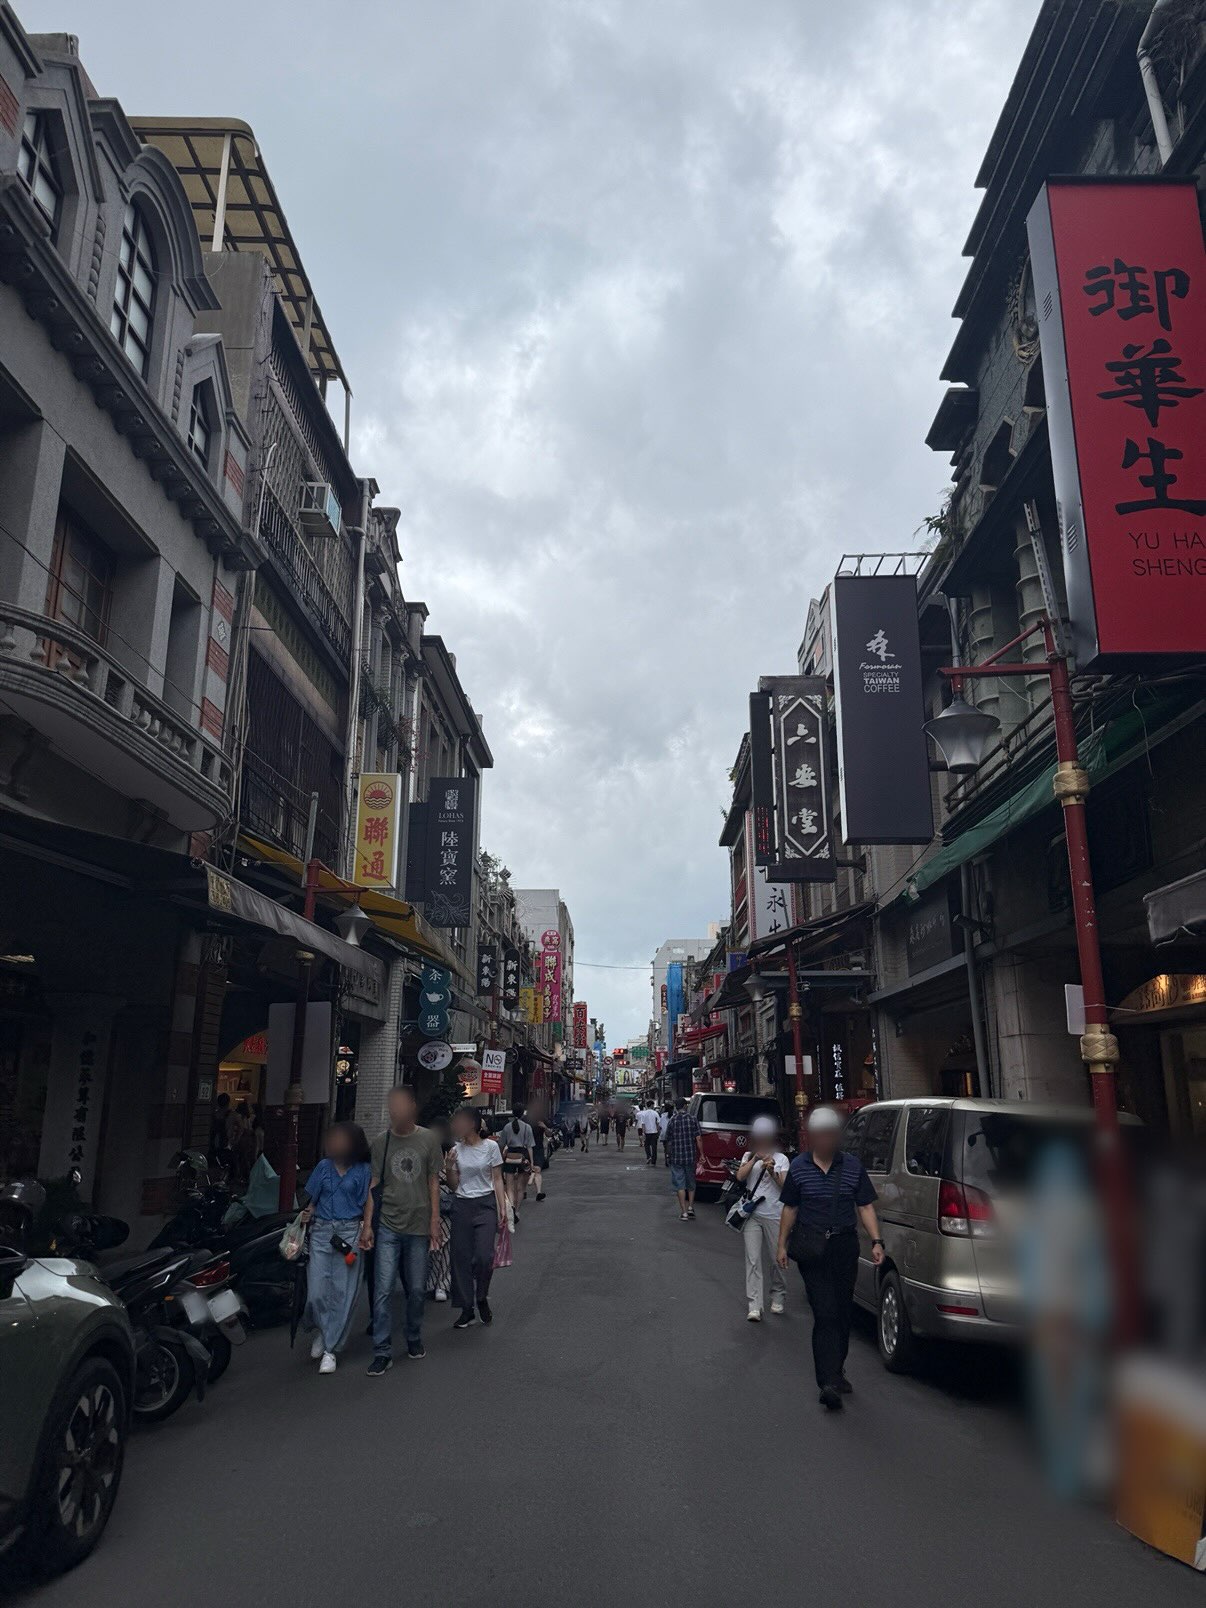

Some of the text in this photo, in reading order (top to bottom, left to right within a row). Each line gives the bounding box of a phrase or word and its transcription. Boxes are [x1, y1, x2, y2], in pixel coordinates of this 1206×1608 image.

[1082, 258, 1206, 516] 御華生
[1128, 532, 1160, 550] YU
[863, 677, 900, 685] TAIWAN
[863, 684, 900, 693] COFFEE
[786, 723, 818, 836] 六安堂
[361, 816, 389, 882] 聯通
[439, 830, 459, 886] 陸寶窯
